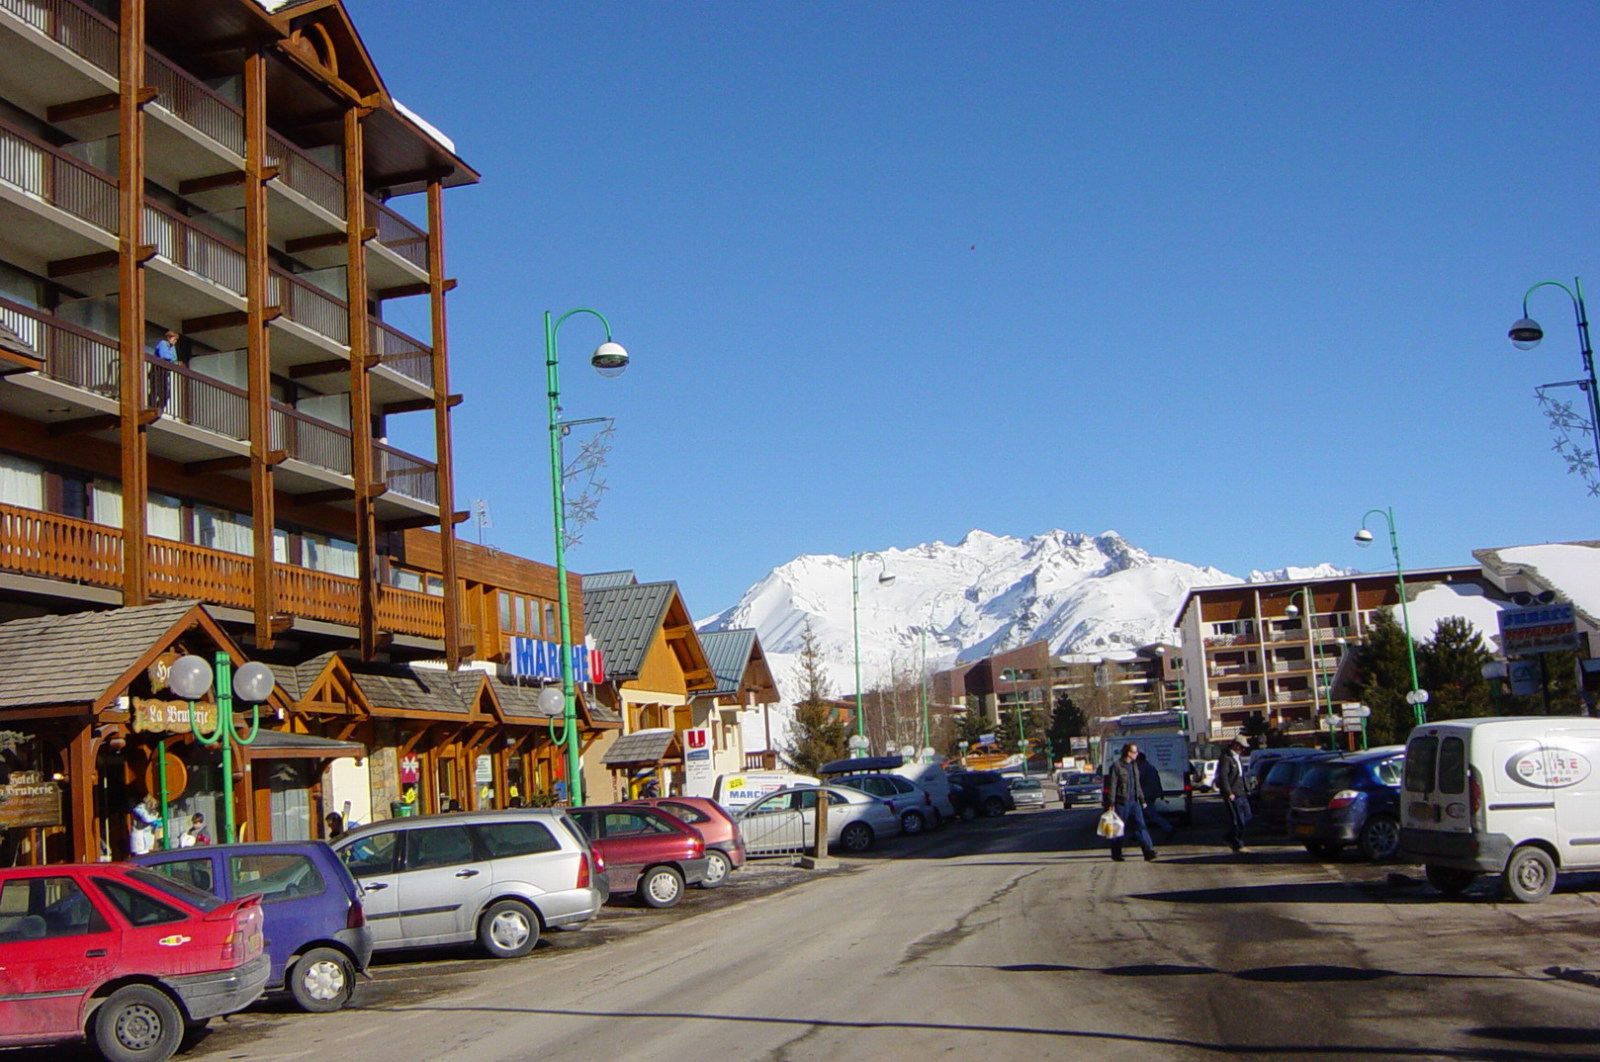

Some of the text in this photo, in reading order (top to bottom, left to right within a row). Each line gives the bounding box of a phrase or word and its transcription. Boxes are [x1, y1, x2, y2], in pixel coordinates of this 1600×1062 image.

[514, 636, 589, 682] MARHE
[149, 704, 209, 726] La Bruerie
[687, 729, 706, 748] U
